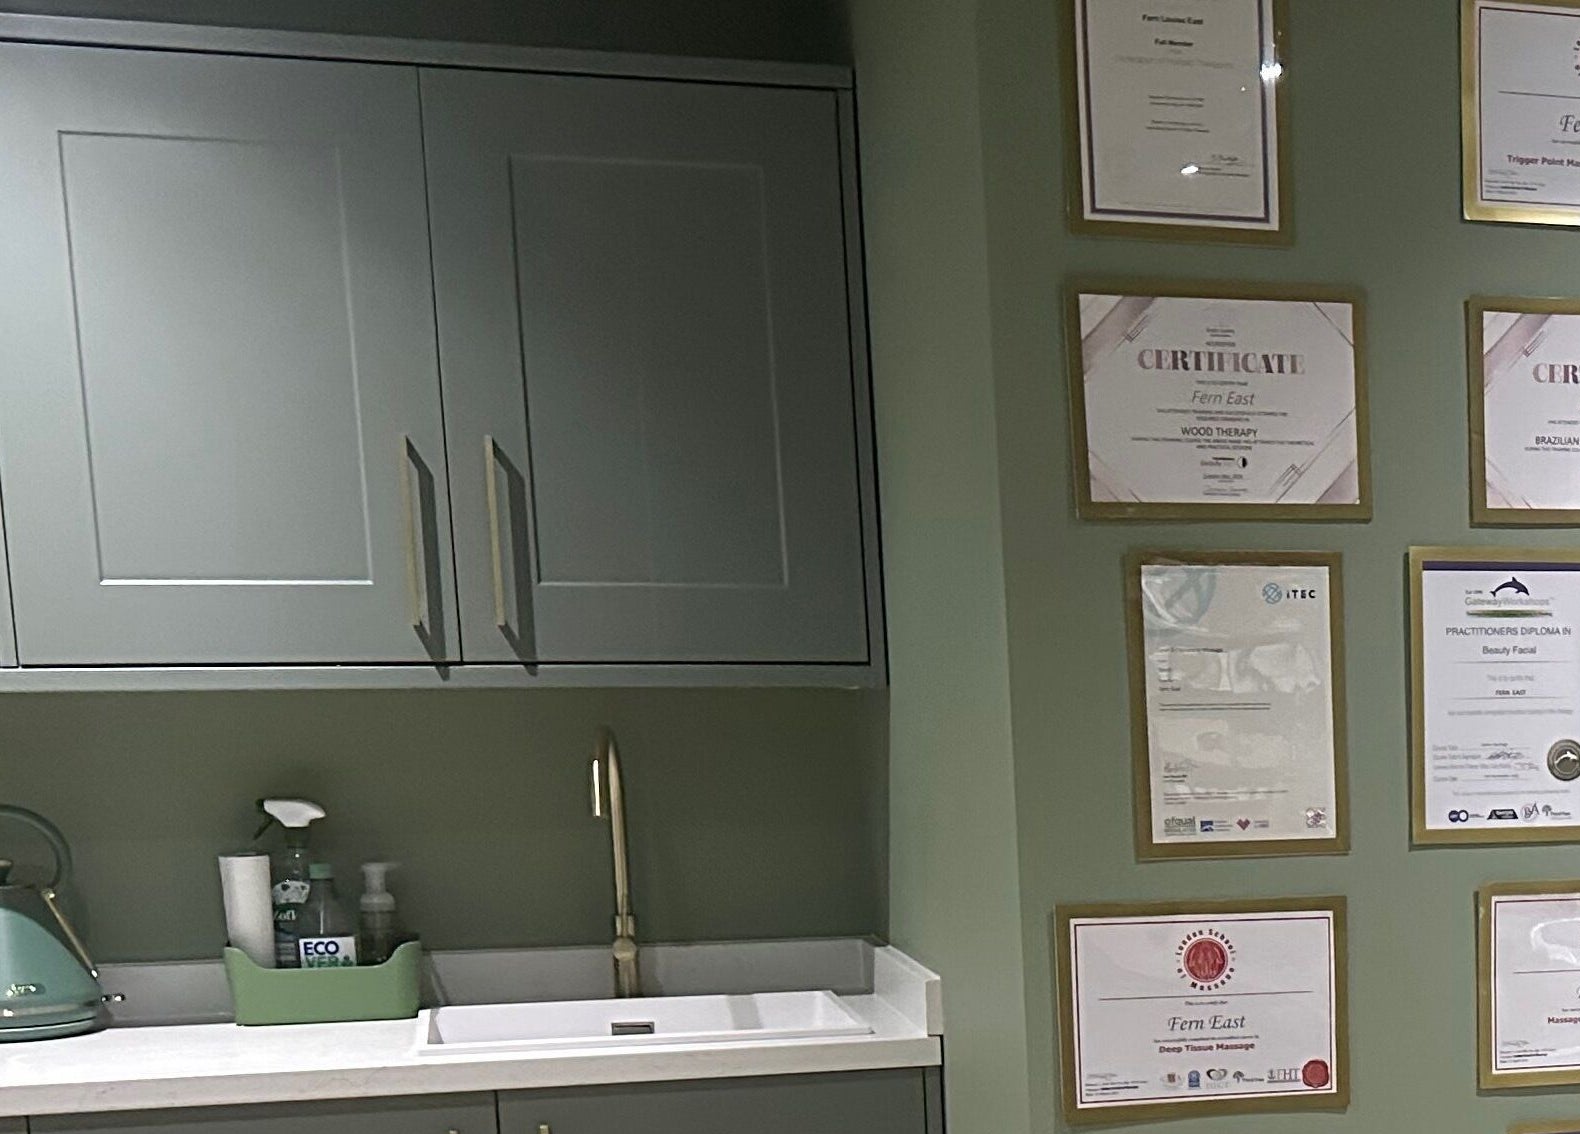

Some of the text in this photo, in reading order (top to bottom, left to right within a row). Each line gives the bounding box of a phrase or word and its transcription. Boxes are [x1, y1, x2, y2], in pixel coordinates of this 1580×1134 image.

[1507, 154, 1539, 165] Trigger
[1542, 157, 1564, 166] Point
[1137, 349, 1306, 375] CERTIFICATE
[1192, 390, 1255, 406] Fern East
[1181, 427, 1258, 438] WOOD THERAPY
[1535, 436, 1580, 446] BRAZILIAN
[1446, 627, 1572, 636] PRACTITIONERS DIPLOMA IN
[1482, 646, 1536, 656] Beauty Facial
[304, 940, 340, 956] ECO
[1168, 1014, 1246, 1032] Fern East
[1159, 1042, 1255, 1054] Deep Tissue Massage
